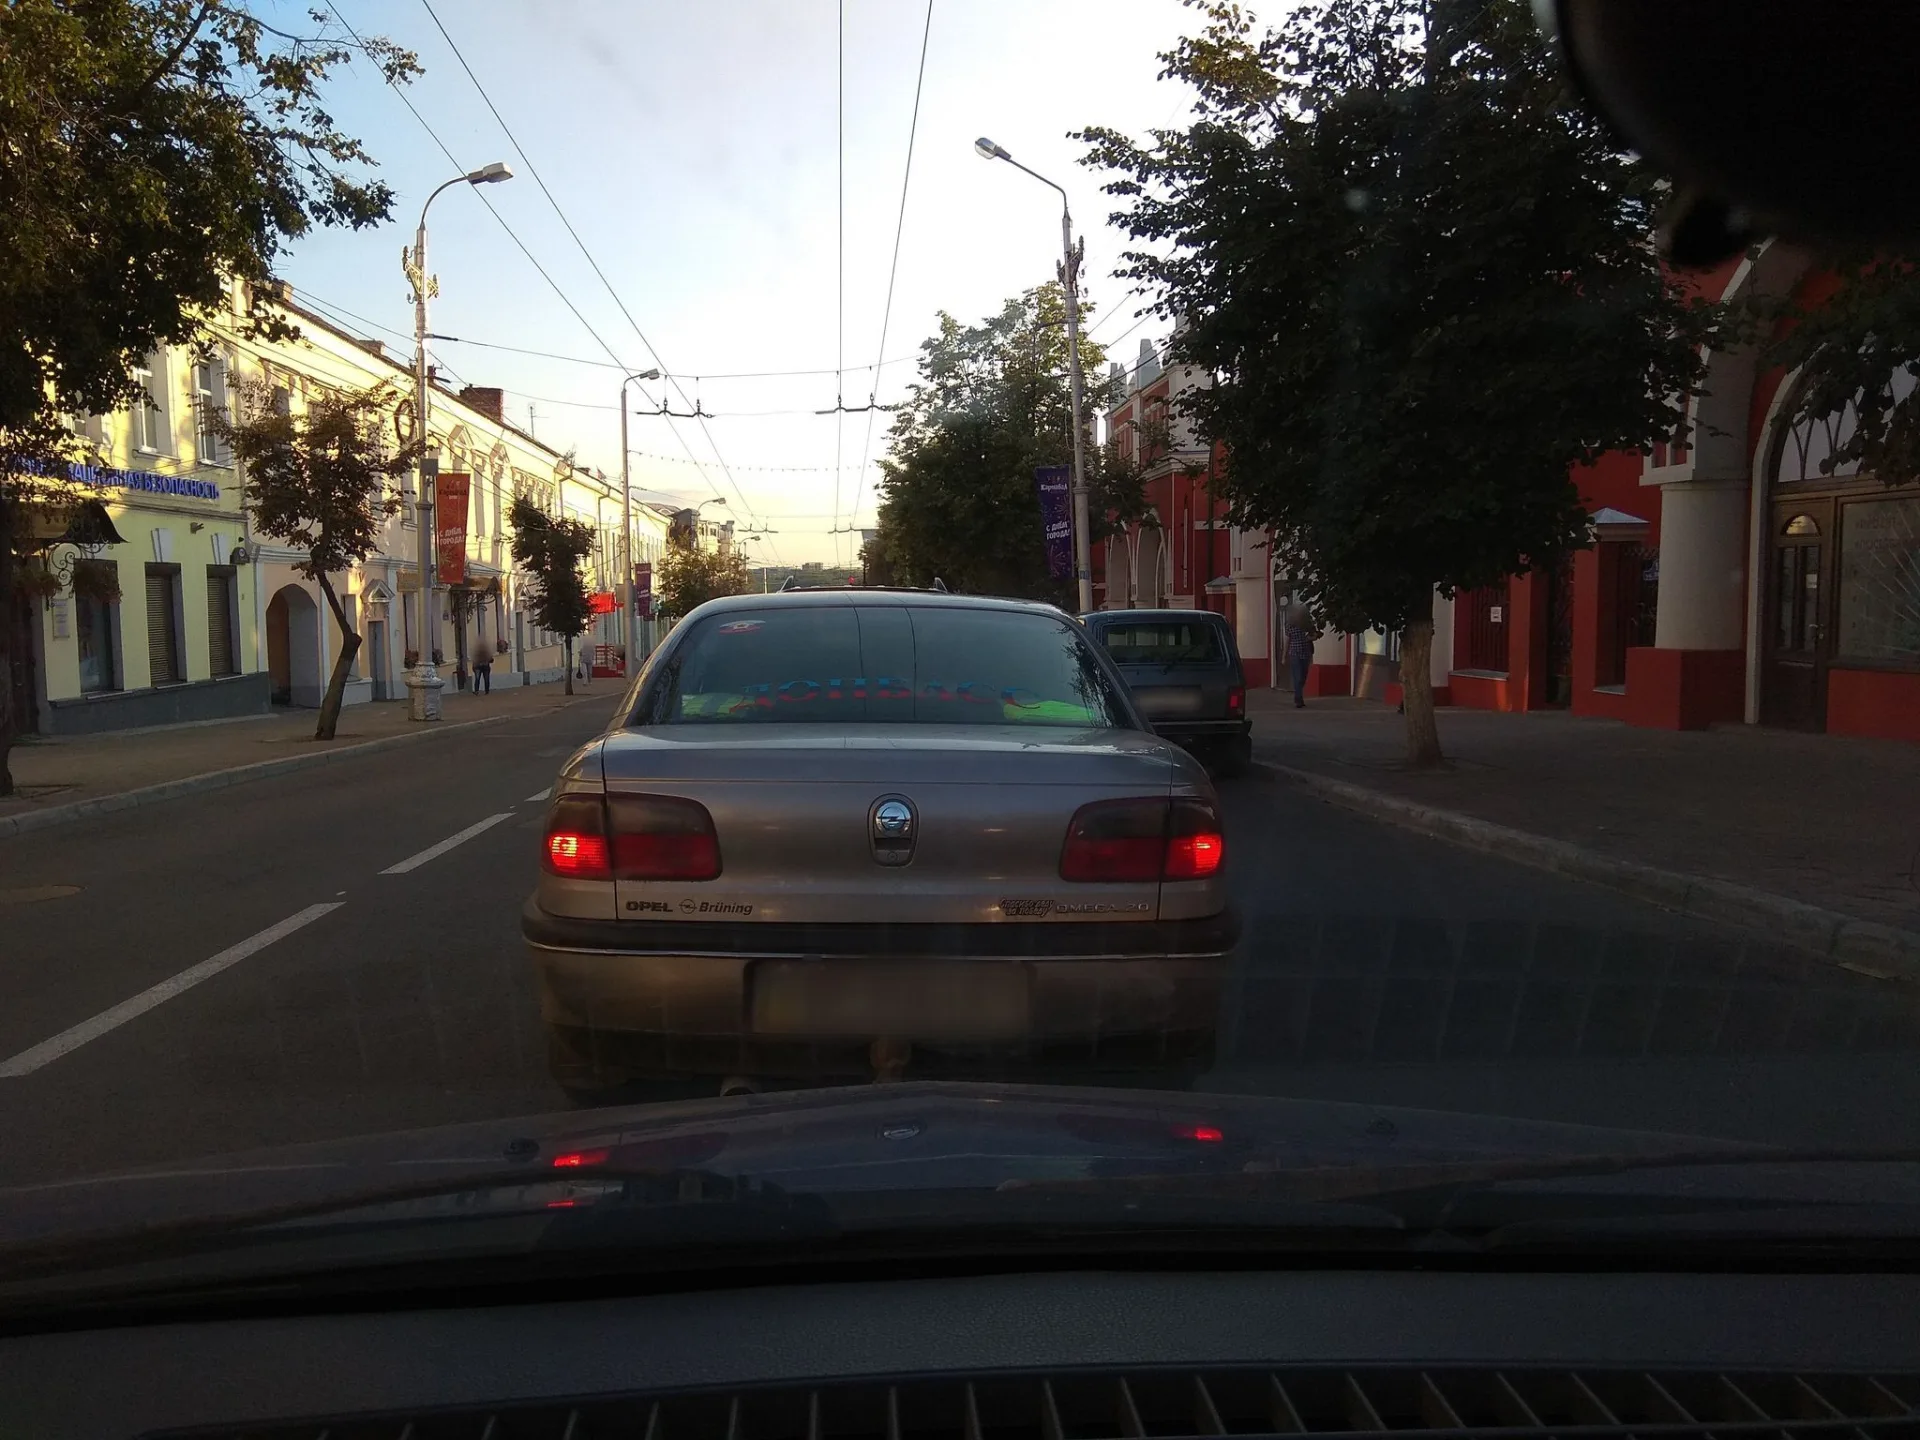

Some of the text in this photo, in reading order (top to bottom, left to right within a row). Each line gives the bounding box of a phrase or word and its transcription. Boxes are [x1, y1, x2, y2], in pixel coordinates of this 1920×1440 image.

[144, 472, 220, 499] БЕЗОПАСНОСТЬ
[626, 901, 753, 915] OPEL Brüning
[1056, 903, 1118, 913] OMEGA
